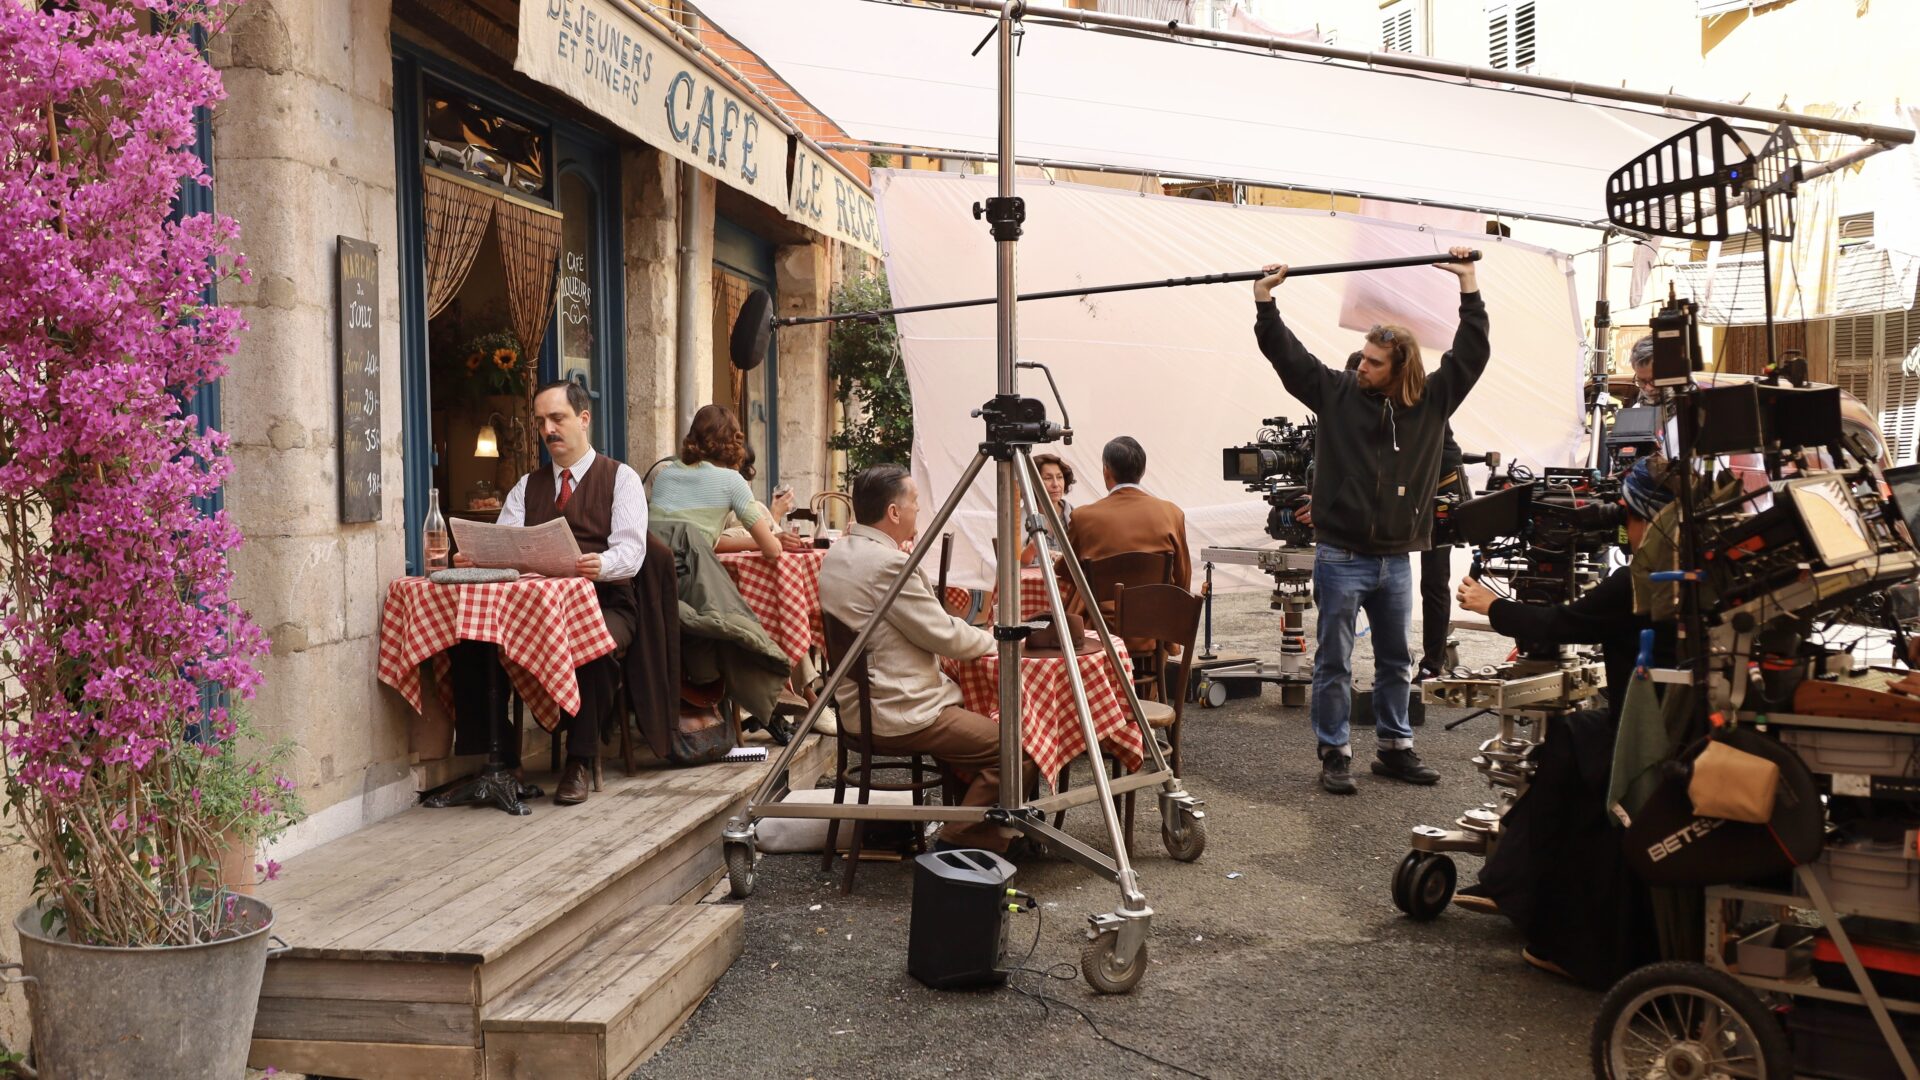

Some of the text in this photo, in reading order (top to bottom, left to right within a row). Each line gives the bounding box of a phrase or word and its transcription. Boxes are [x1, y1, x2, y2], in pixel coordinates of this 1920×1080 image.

[558, 30, 640, 106] ET DINERS
[664, 70, 760, 186] CAFE
[796, 152, 882, 250] LE REGE
